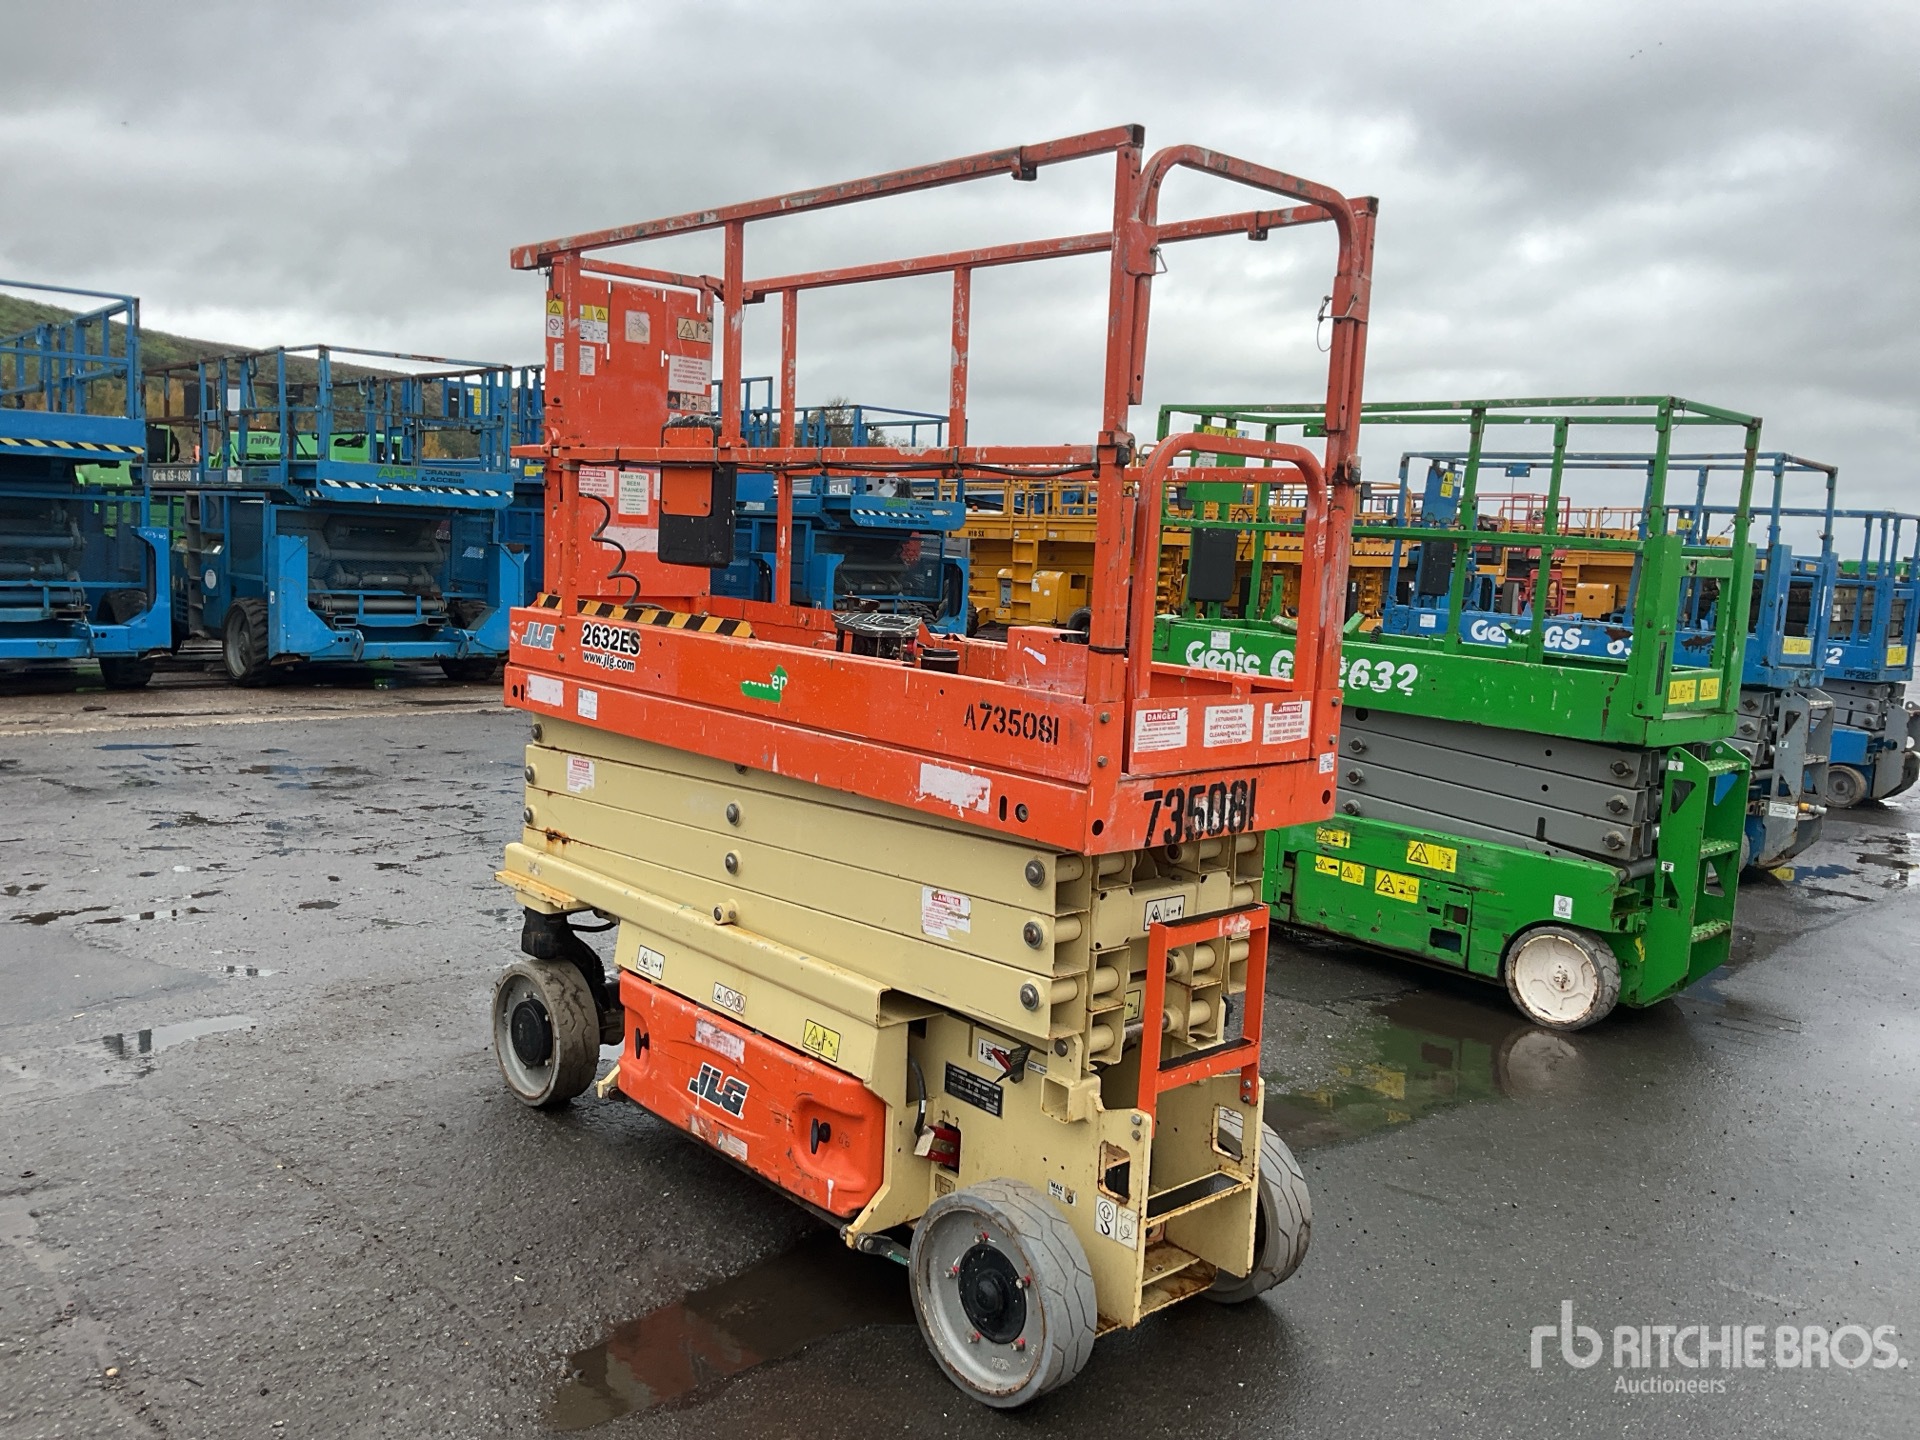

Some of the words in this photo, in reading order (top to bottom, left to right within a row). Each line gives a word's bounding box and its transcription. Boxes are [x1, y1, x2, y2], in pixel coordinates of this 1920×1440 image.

[250, 435, 277, 447] nifty
[521, 621, 556, 650] JLG
[581, 622, 641, 656] 2632ES
[582, 651, 635, 672] www.jlg.com
[1147, 712, 1176, 721] DANGER
[1143, 777, 1257, 848] 735081
[687, 1062, 750, 1119] JLG
[1050, 1182, 1063, 1192] MAX
